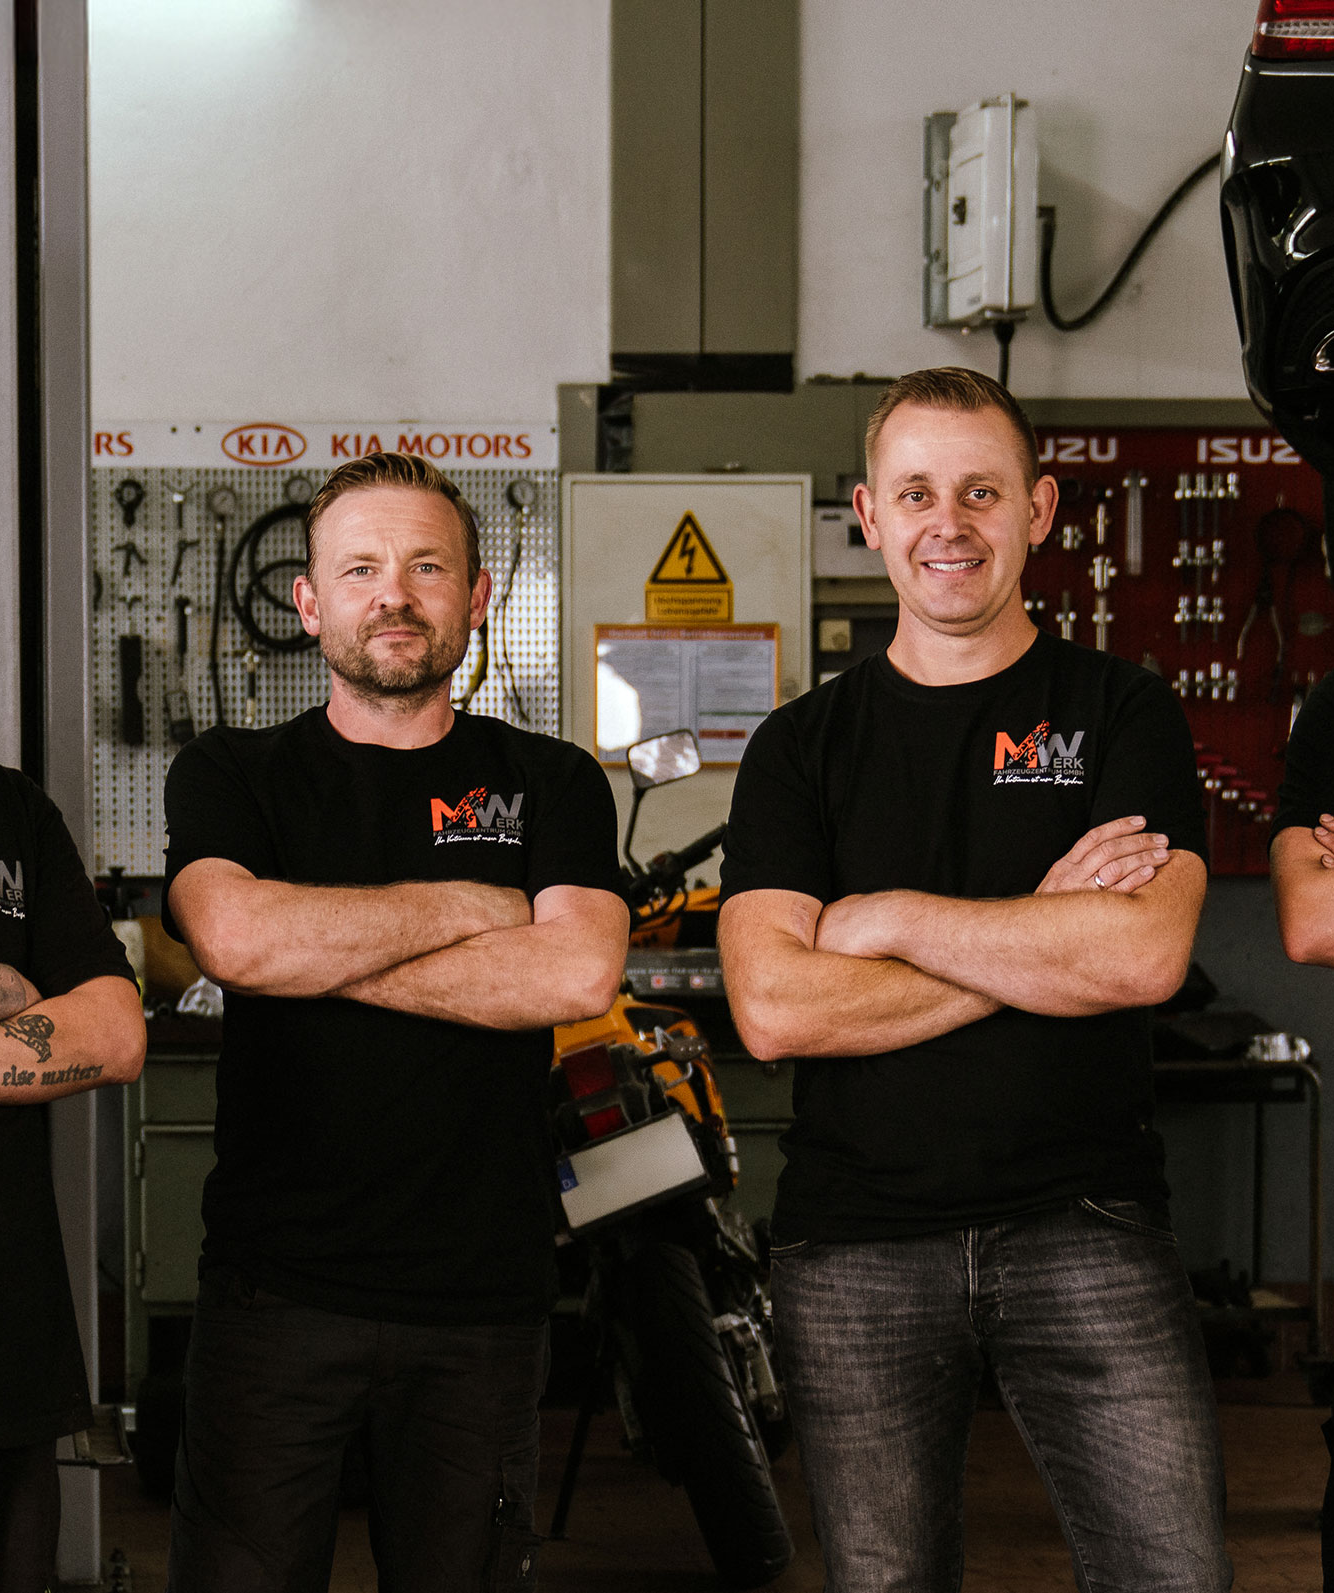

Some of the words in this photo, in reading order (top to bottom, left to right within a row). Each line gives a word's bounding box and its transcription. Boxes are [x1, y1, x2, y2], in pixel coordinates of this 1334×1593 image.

[94, 431, 134, 457] RS
[237, 433, 294, 456] KIA
[331, 433, 382, 457] KIA
[397, 433, 532, 458] MOTORS
[1, 1064, 36, 1087] else
[40, 1064, 104, 1086] matters
